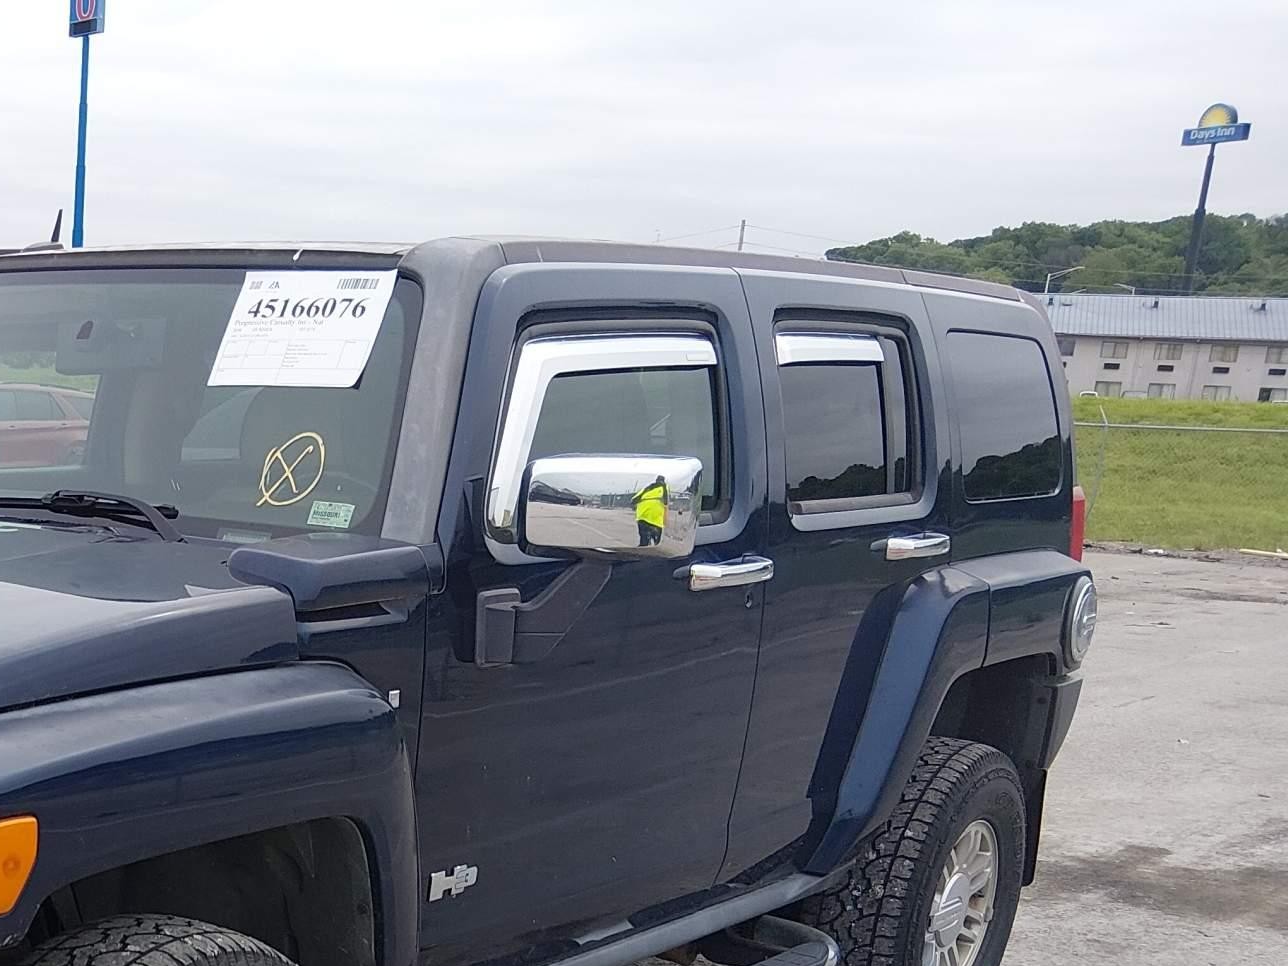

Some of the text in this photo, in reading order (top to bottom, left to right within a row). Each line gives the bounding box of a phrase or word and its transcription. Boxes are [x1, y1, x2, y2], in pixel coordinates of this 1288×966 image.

[1190, 129, 1216, 140] Days
[1217, 127, 1236, 137] Inn
[248, 297, 370, 319] 45166076
[429, 864, 479, 902] H3
